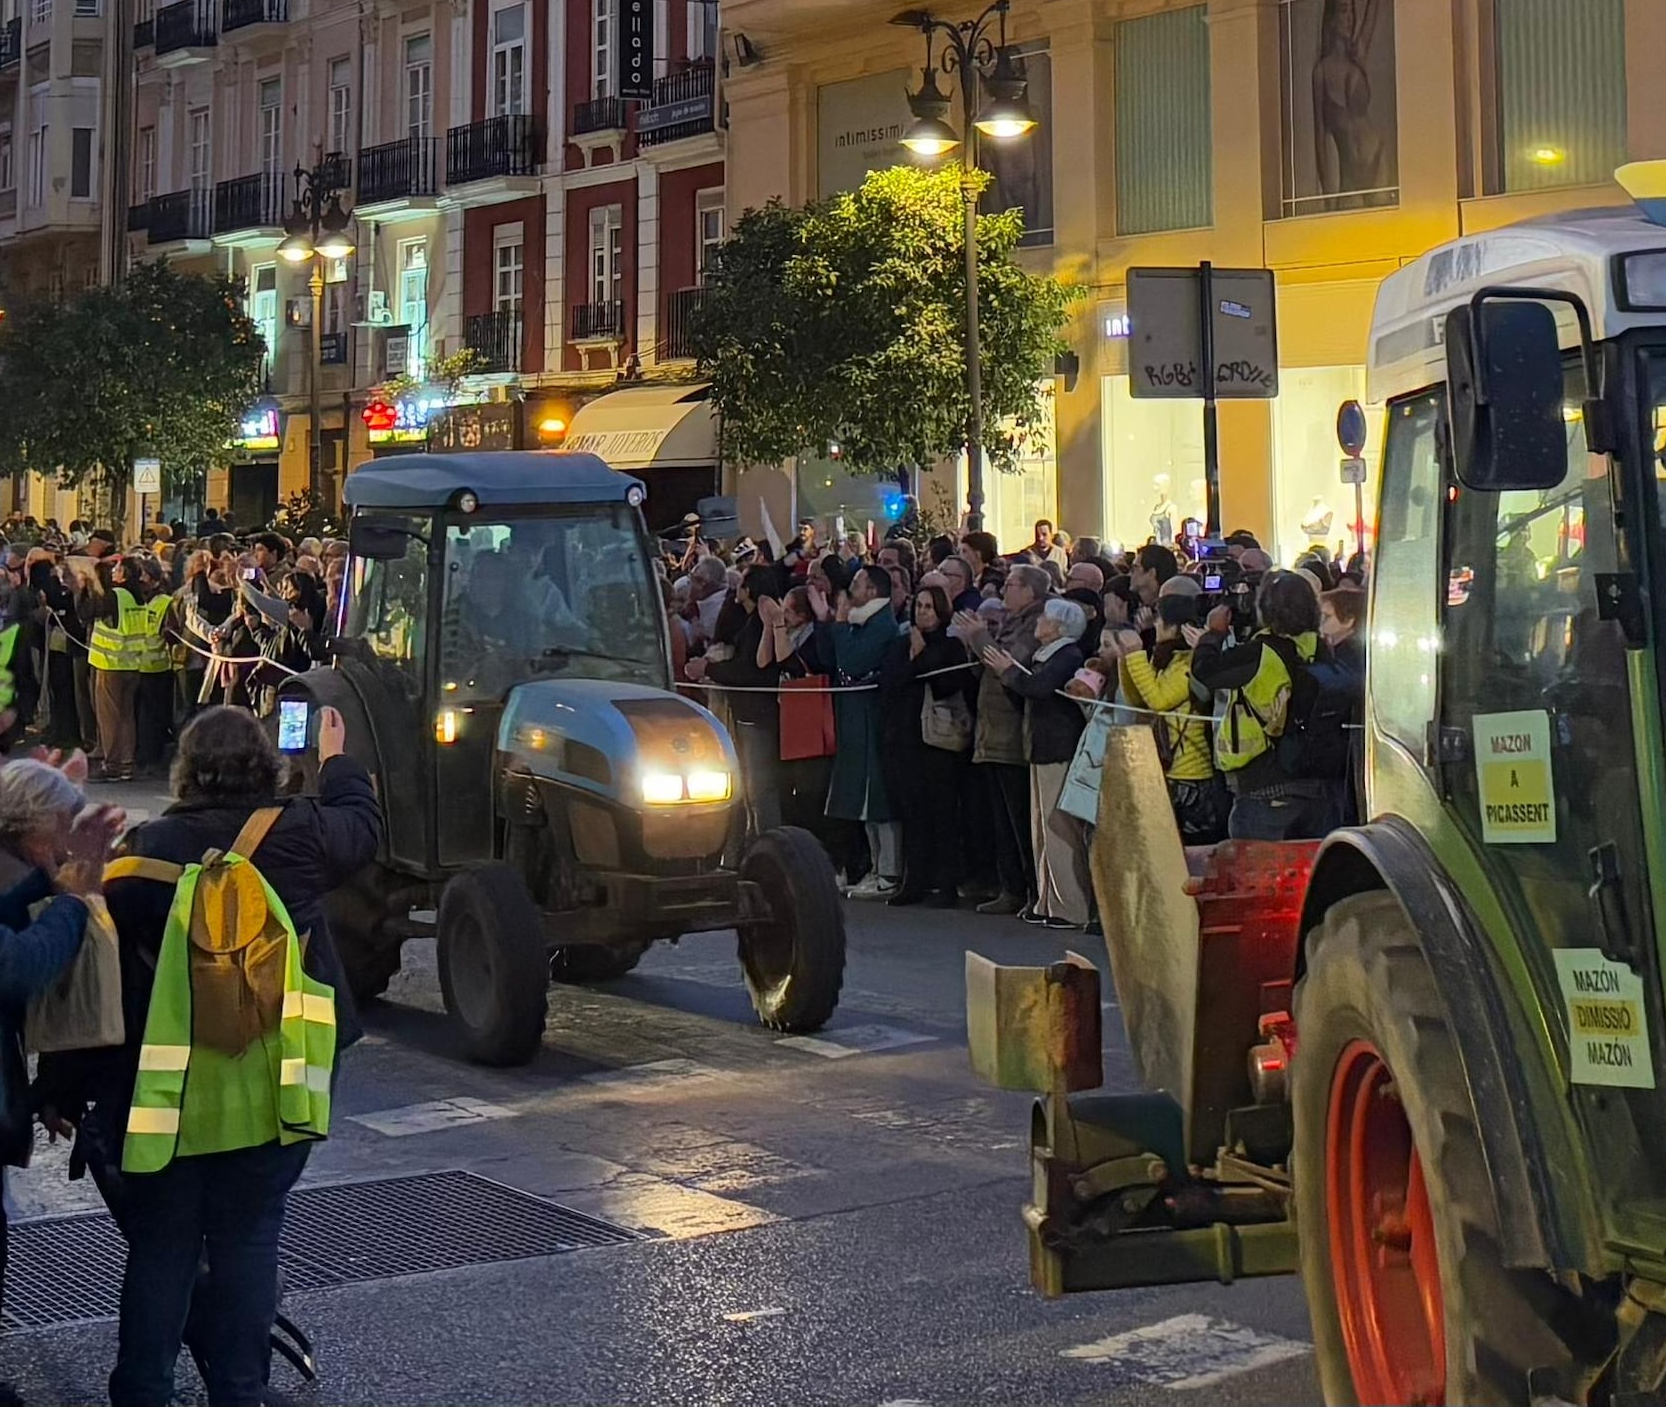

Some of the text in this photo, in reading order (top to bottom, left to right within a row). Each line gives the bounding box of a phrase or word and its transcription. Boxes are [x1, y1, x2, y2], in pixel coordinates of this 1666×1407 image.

[1510, 769, 1520, 788] A
[1486, 802, 1550, 824] PICASSENT
[1573, 963, 1620, 993] MAZÓN
[1576, 1002, 1631, 1030] DIMISSIÓ
[1587, 1038, 1632, 1067] MAZÓN
